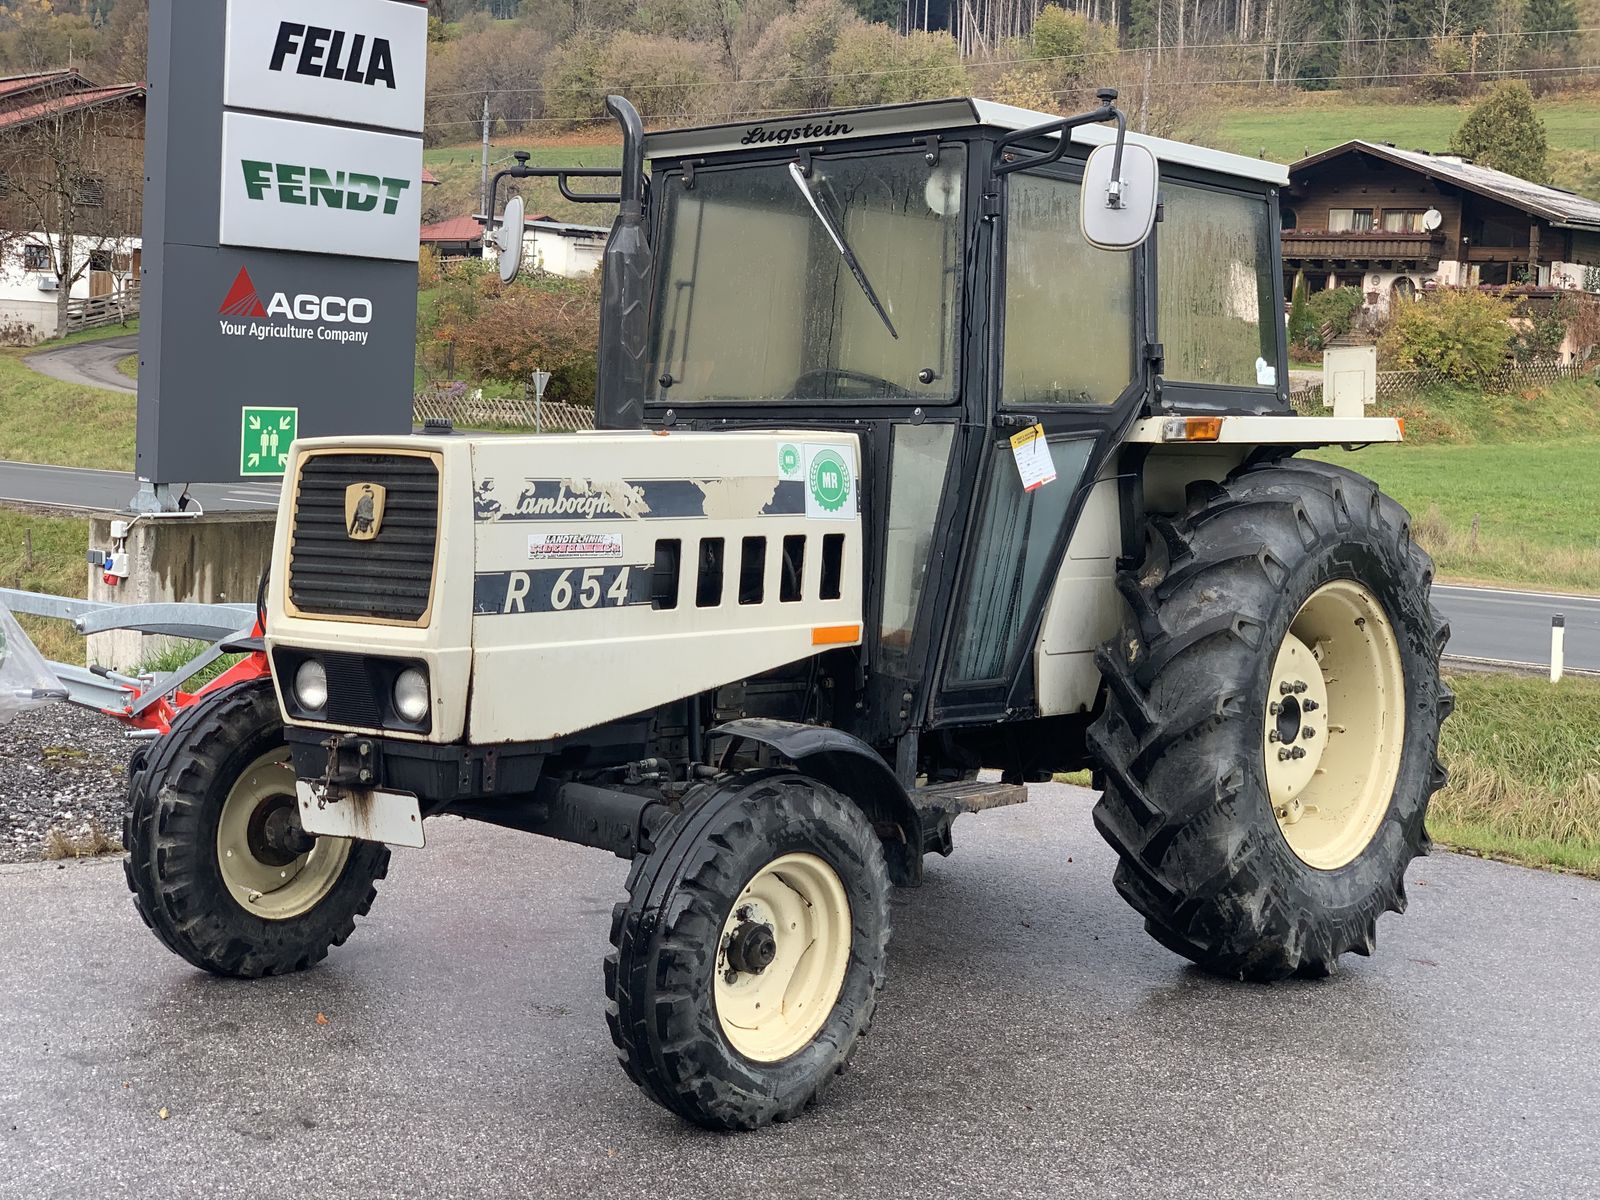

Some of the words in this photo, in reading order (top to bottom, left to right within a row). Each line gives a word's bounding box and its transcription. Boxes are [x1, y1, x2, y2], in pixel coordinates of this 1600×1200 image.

[268, 21, 396, 90] FELLA
[741, 120, 854, 144] Lugstein
[240, 159, 411, 215] FENDT
[267, 292, 373, 324] AGCO
[219, 320, 247, 336] Your
[249, 322, 314, 341] Agriculture
[317, 326, 369, 345] Company
[822, 472, 838, 488] MR
[505, 481, 643, 519] Lamborgh
[503, 571, 531, 613] R
[550, 566, 631, 611] 654
